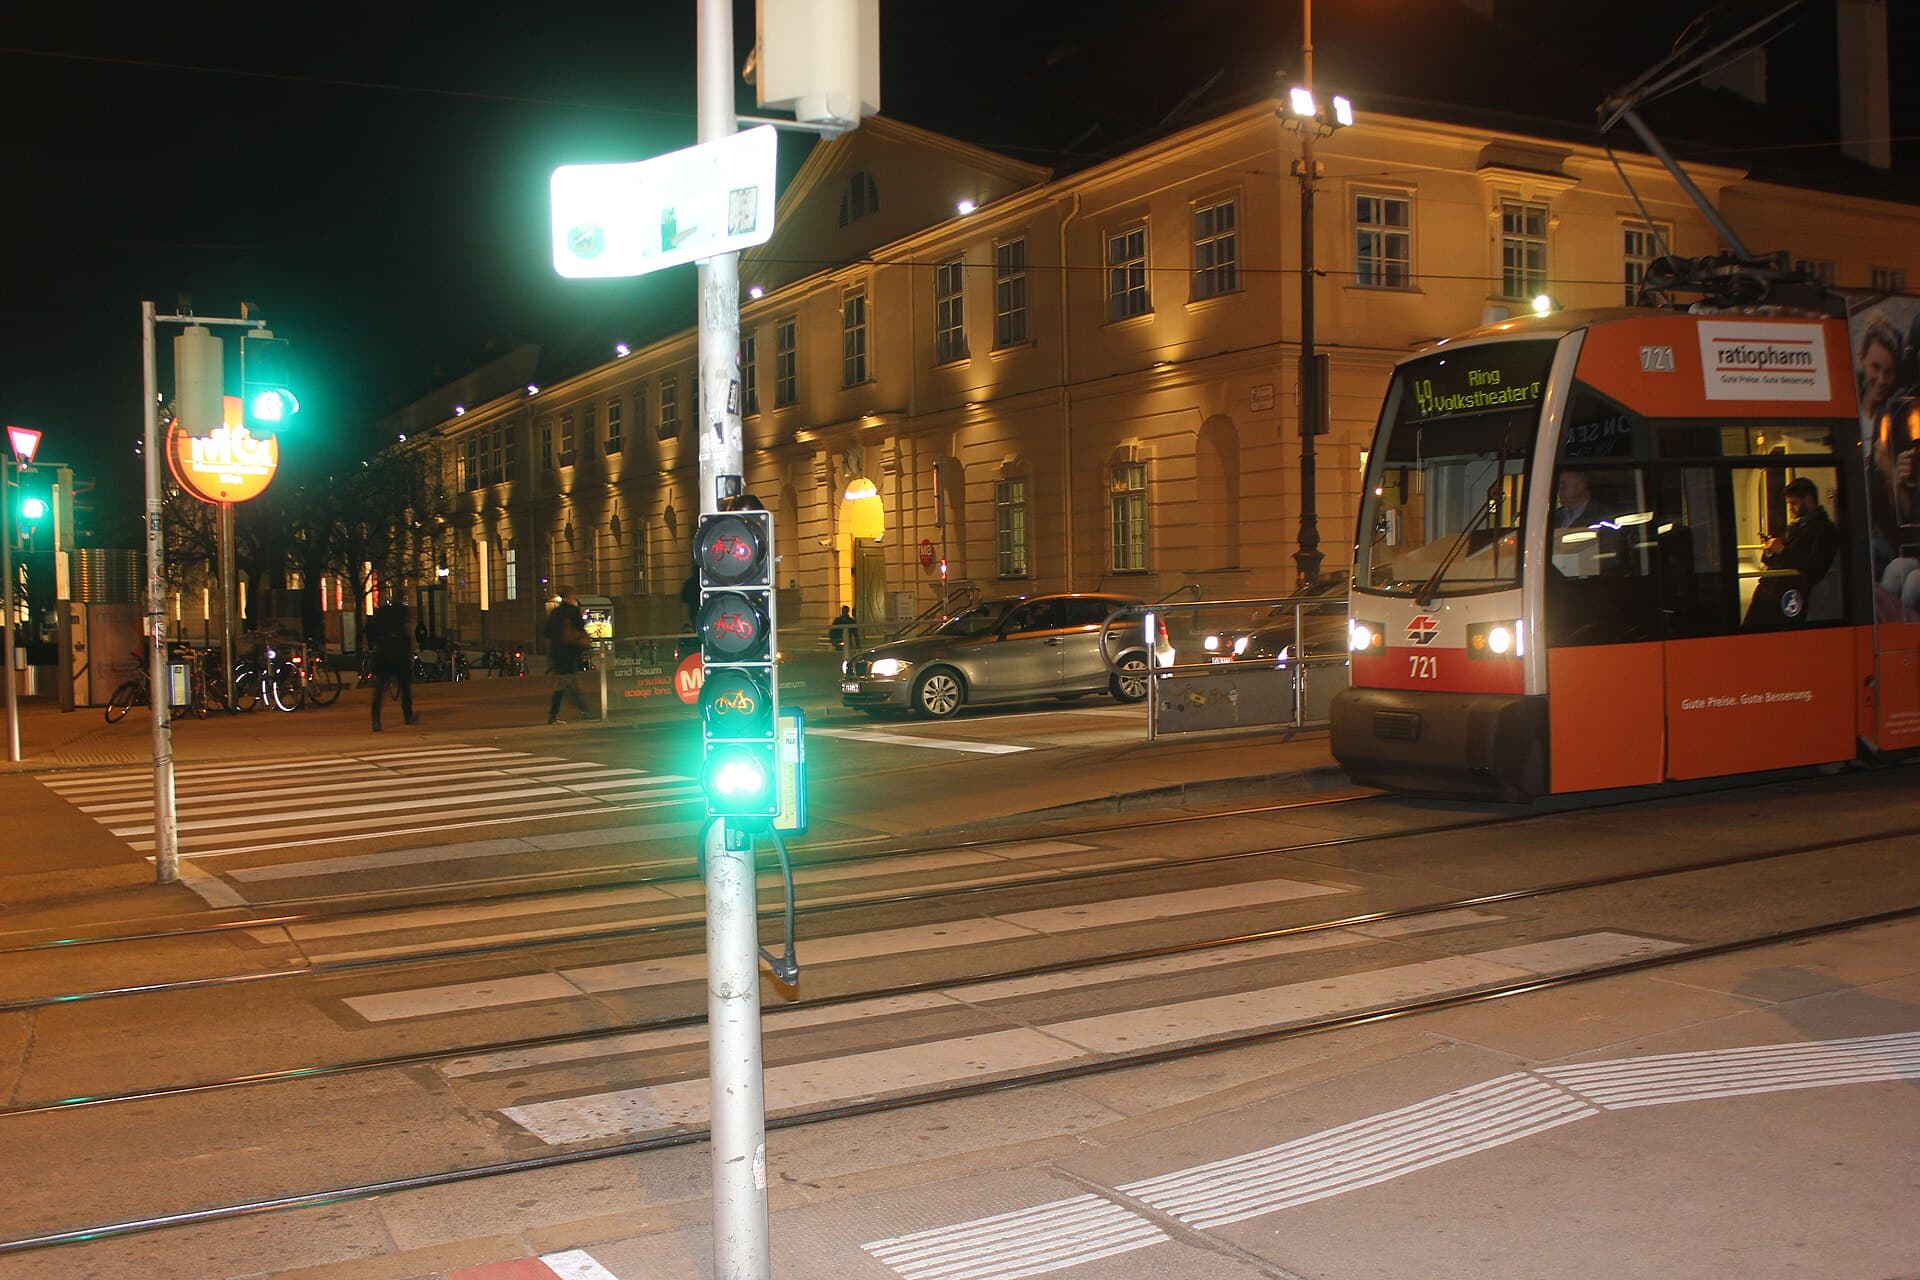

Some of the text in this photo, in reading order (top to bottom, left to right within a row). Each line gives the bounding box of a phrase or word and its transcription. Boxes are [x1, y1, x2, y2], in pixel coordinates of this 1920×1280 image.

[1718, 345, 1812, 368] ratiopharm
[1468, 369, 1500, 387] Ring
[1416, 380, 1433, 412] 49
[1435, 386, 1529, 412] Volkstheater
[635, 666, 662, 676] Raum
[1409, 655, 1437, 679] 721
[1682, 698, 1705, 710] Gute
[1740, 693, 1764, 705] Gute
